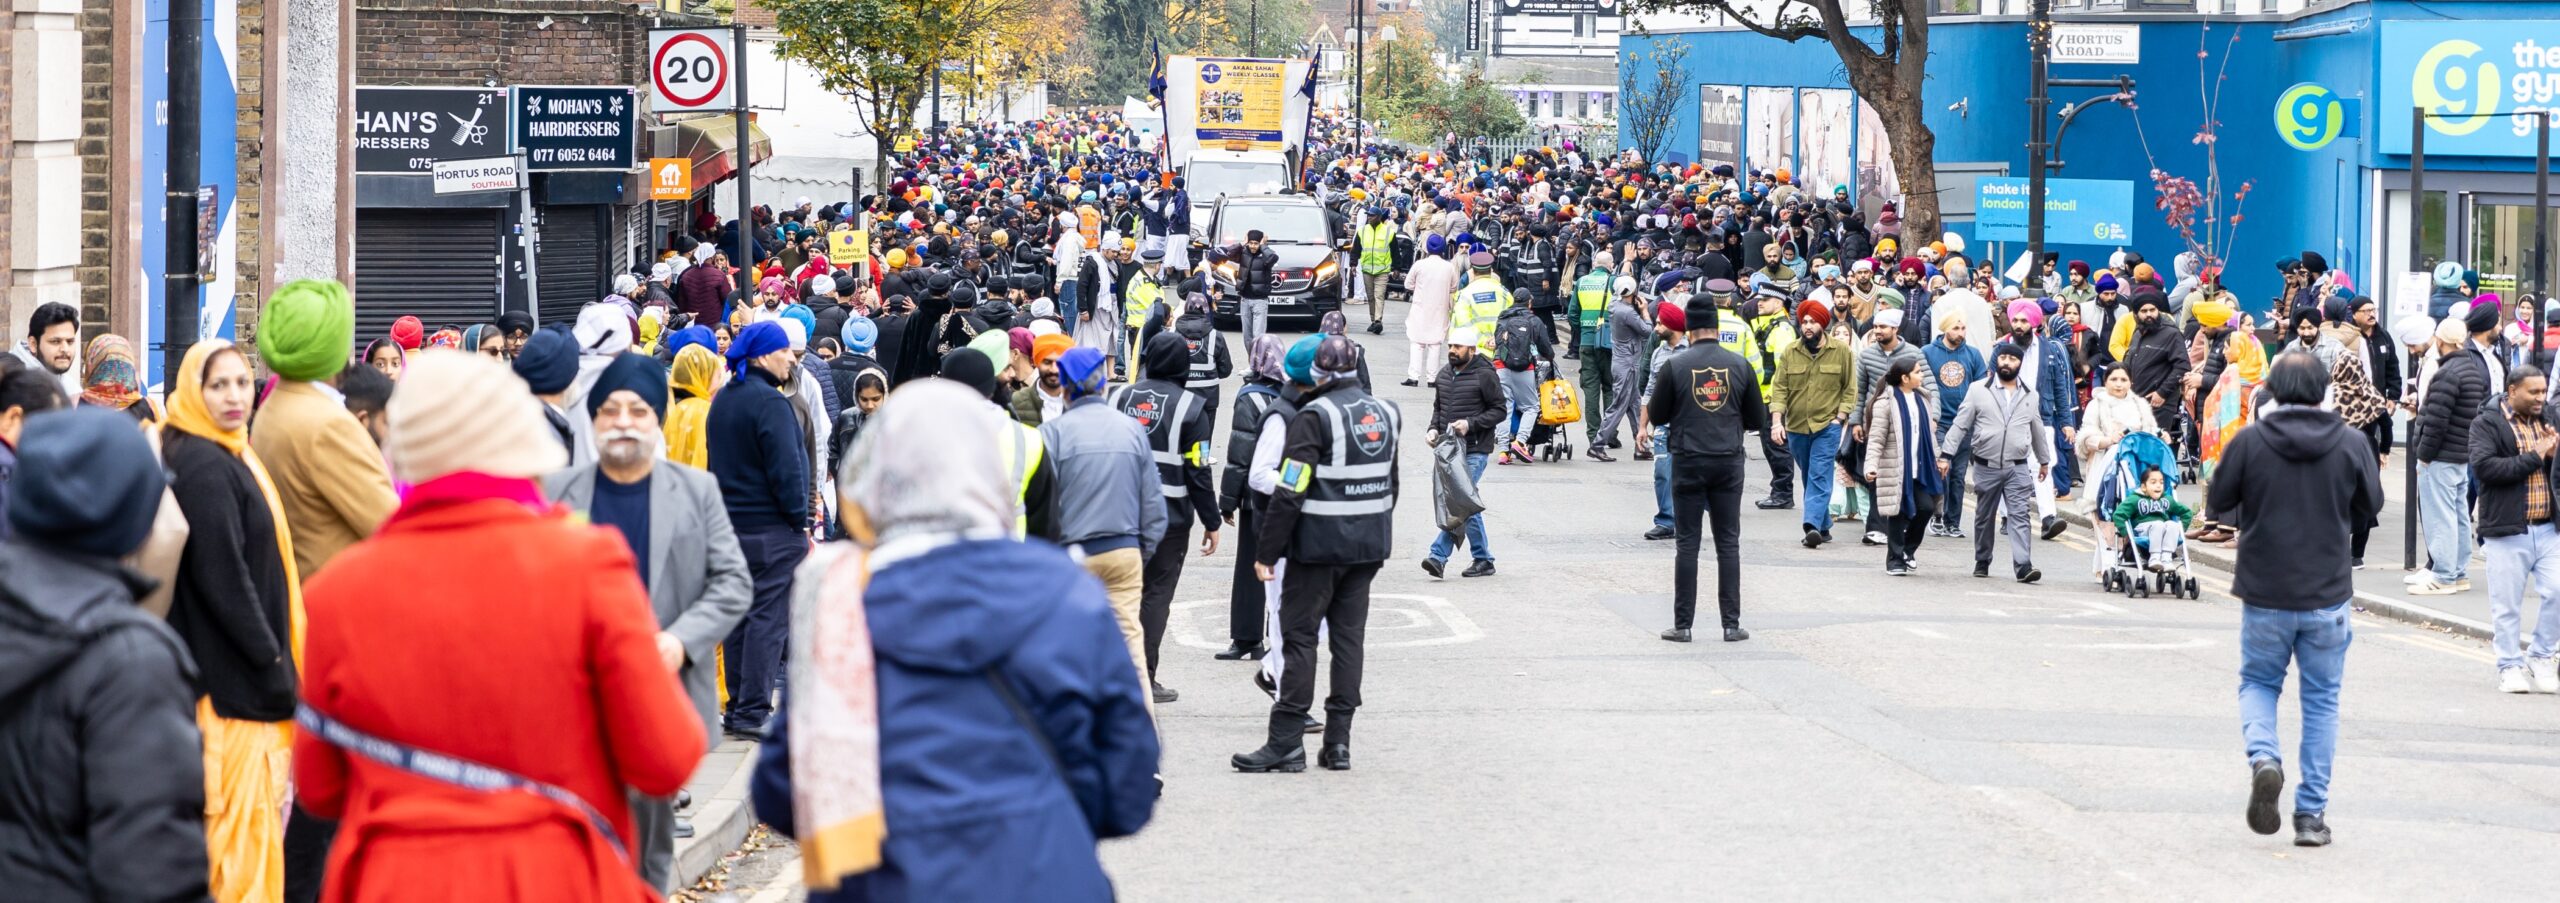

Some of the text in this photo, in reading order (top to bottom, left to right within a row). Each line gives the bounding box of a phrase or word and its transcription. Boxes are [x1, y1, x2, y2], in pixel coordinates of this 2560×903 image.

[2066, 35, 2122, 45] HORTUS
[2066, 47, 2104, 56] ROAD
[2512, 39, 2560, 68] the
[667, 56, 714, 83] 20
[478, 94, 492, 104] 21
[548, 98, 602, 115] MOHAN'S
[356, 111, 437, 133] HAN'S
[529, 121, 620, 137] HAIRDRESSERS
[356, 137, 430, 149] DRESSERS
[533, 148, 615, 161] 077 6052 6464
[409, 158, 437, 168] 075
[436, 166, 513, 180] HORTUS ROAD
[471, 180, 514, 189] SOUTHALL
[1982, 183, 2030, 195] shake it
[655, 187, 672, 195] JUST
[1982, 198, 2024, 209] london
[832, 253, 867, 261] Suspension
[1719, 333, 1737, 342] LICE
[1696, 386, 1727, 395] KNIGHTS
[1127, 407, 1160, 420] KNIGHTS
[1354, 421, 1386, 435] KNIGHTS
[1345, 482, 1390, 495] MARSHAL
[2137, 498, 2171, 516] GAP
